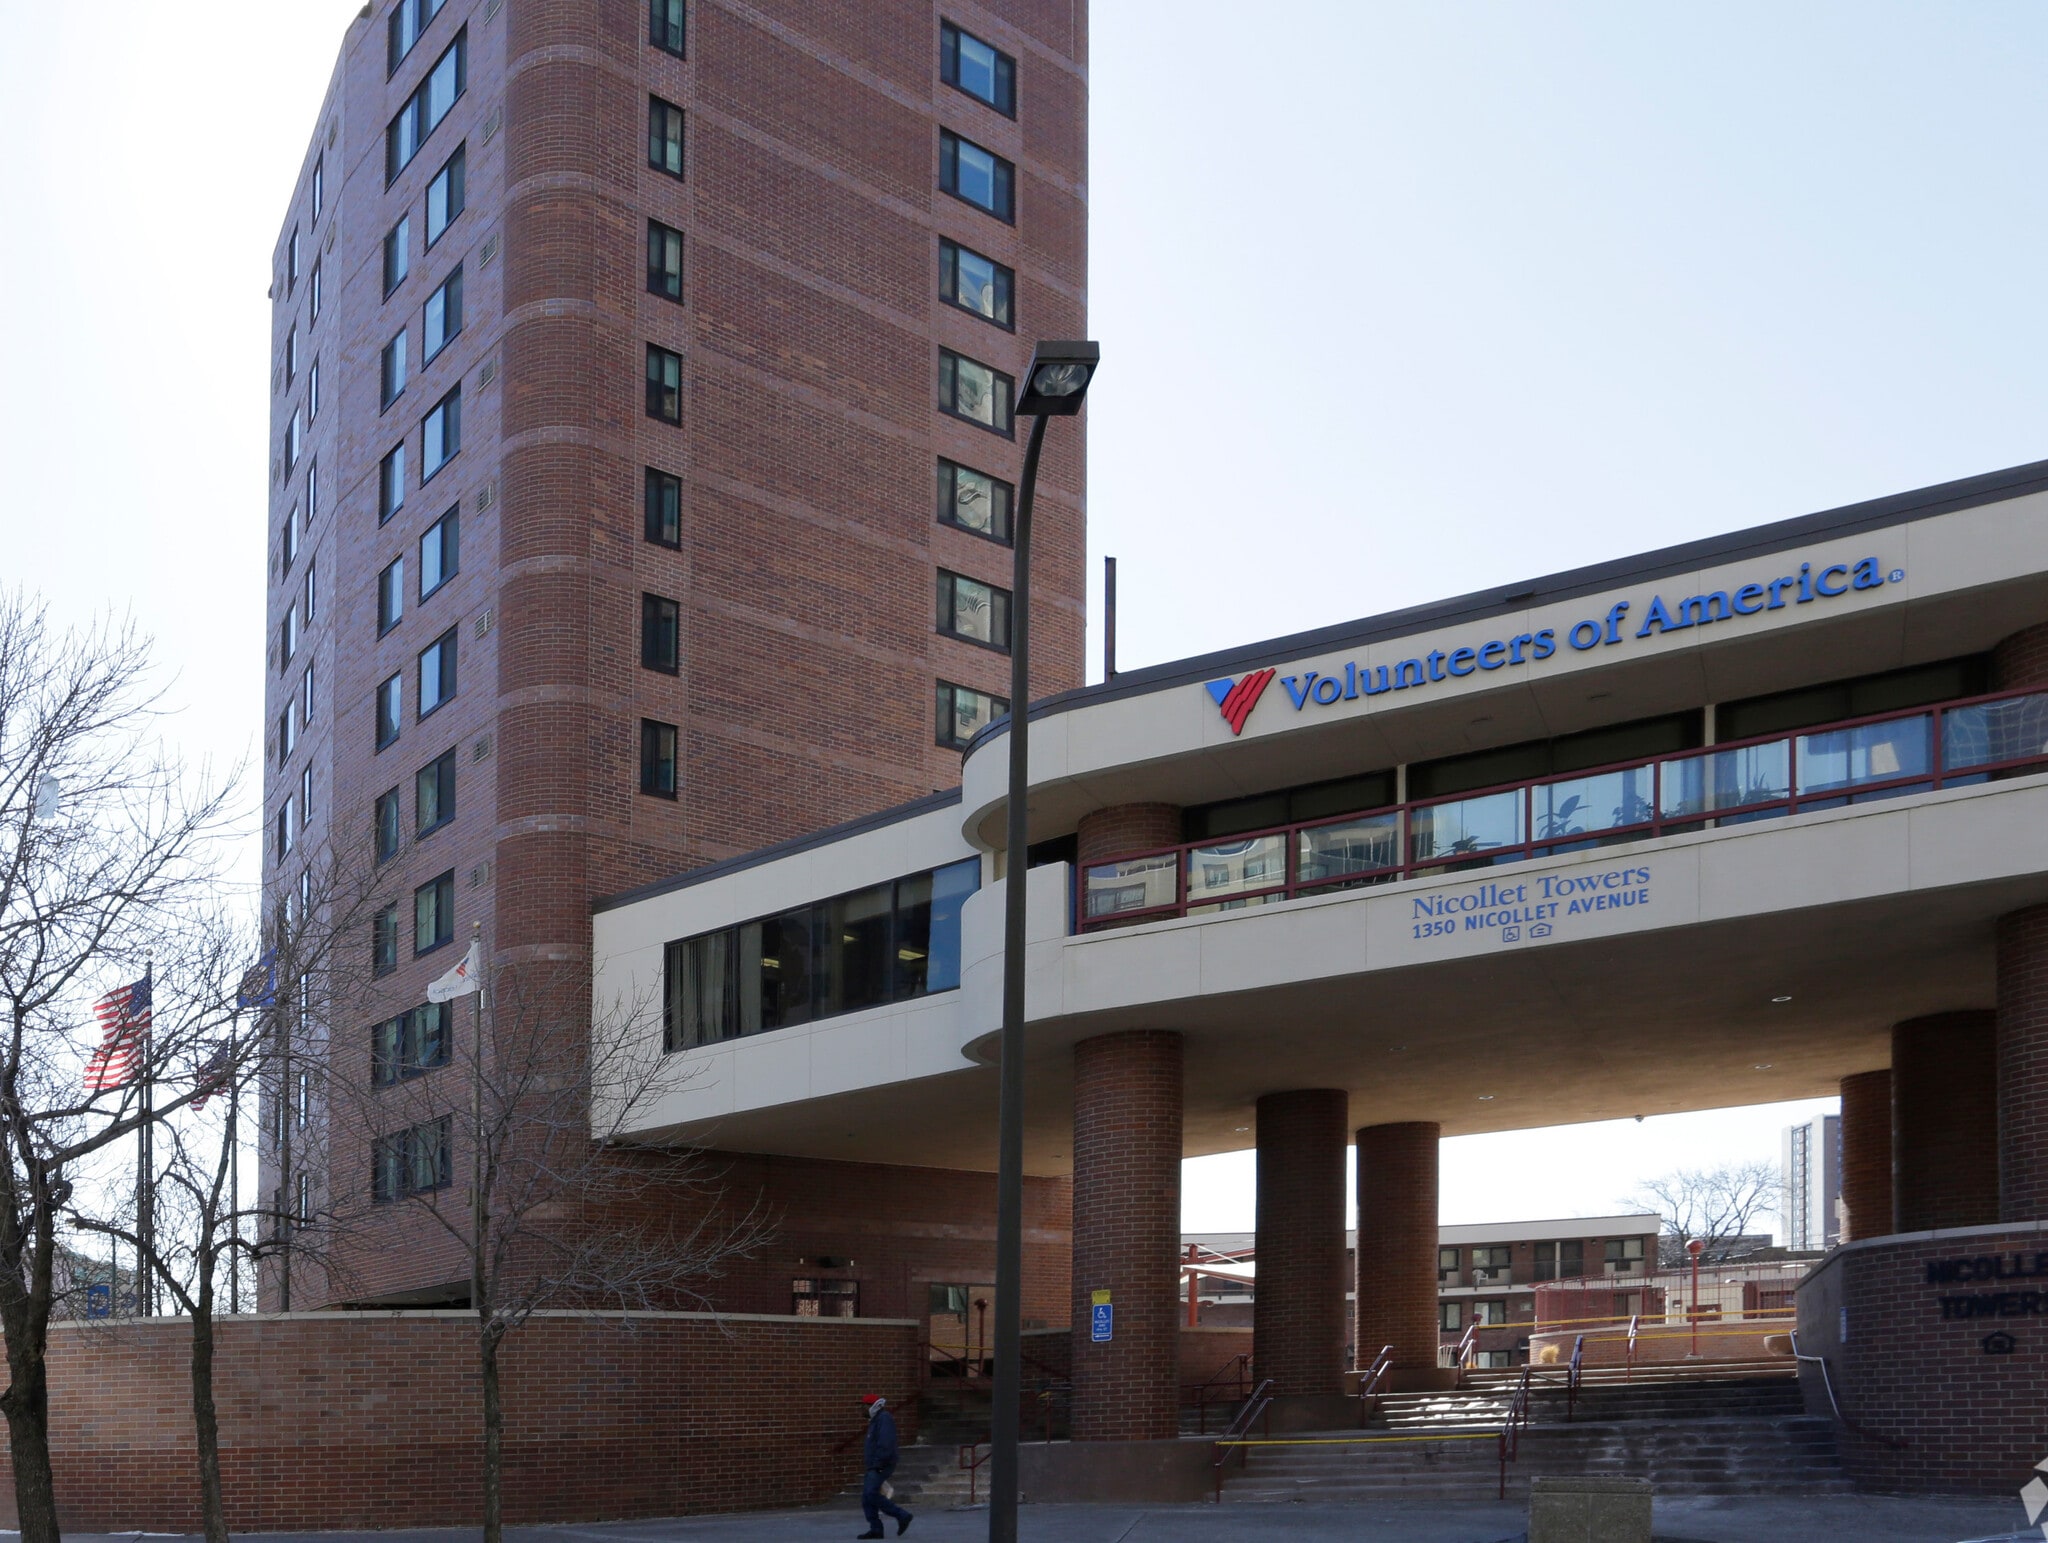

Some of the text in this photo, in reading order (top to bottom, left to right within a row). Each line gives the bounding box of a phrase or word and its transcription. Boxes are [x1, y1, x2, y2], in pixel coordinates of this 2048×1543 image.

[1280, 628, 1557, 711] Volunteers
[1568, 601, 1630, 650] of
[1412, 867, 1651, 919] Nicollet Towers
[1412, 888, 1650, 939] 1350 NICOLLET AVENUE
